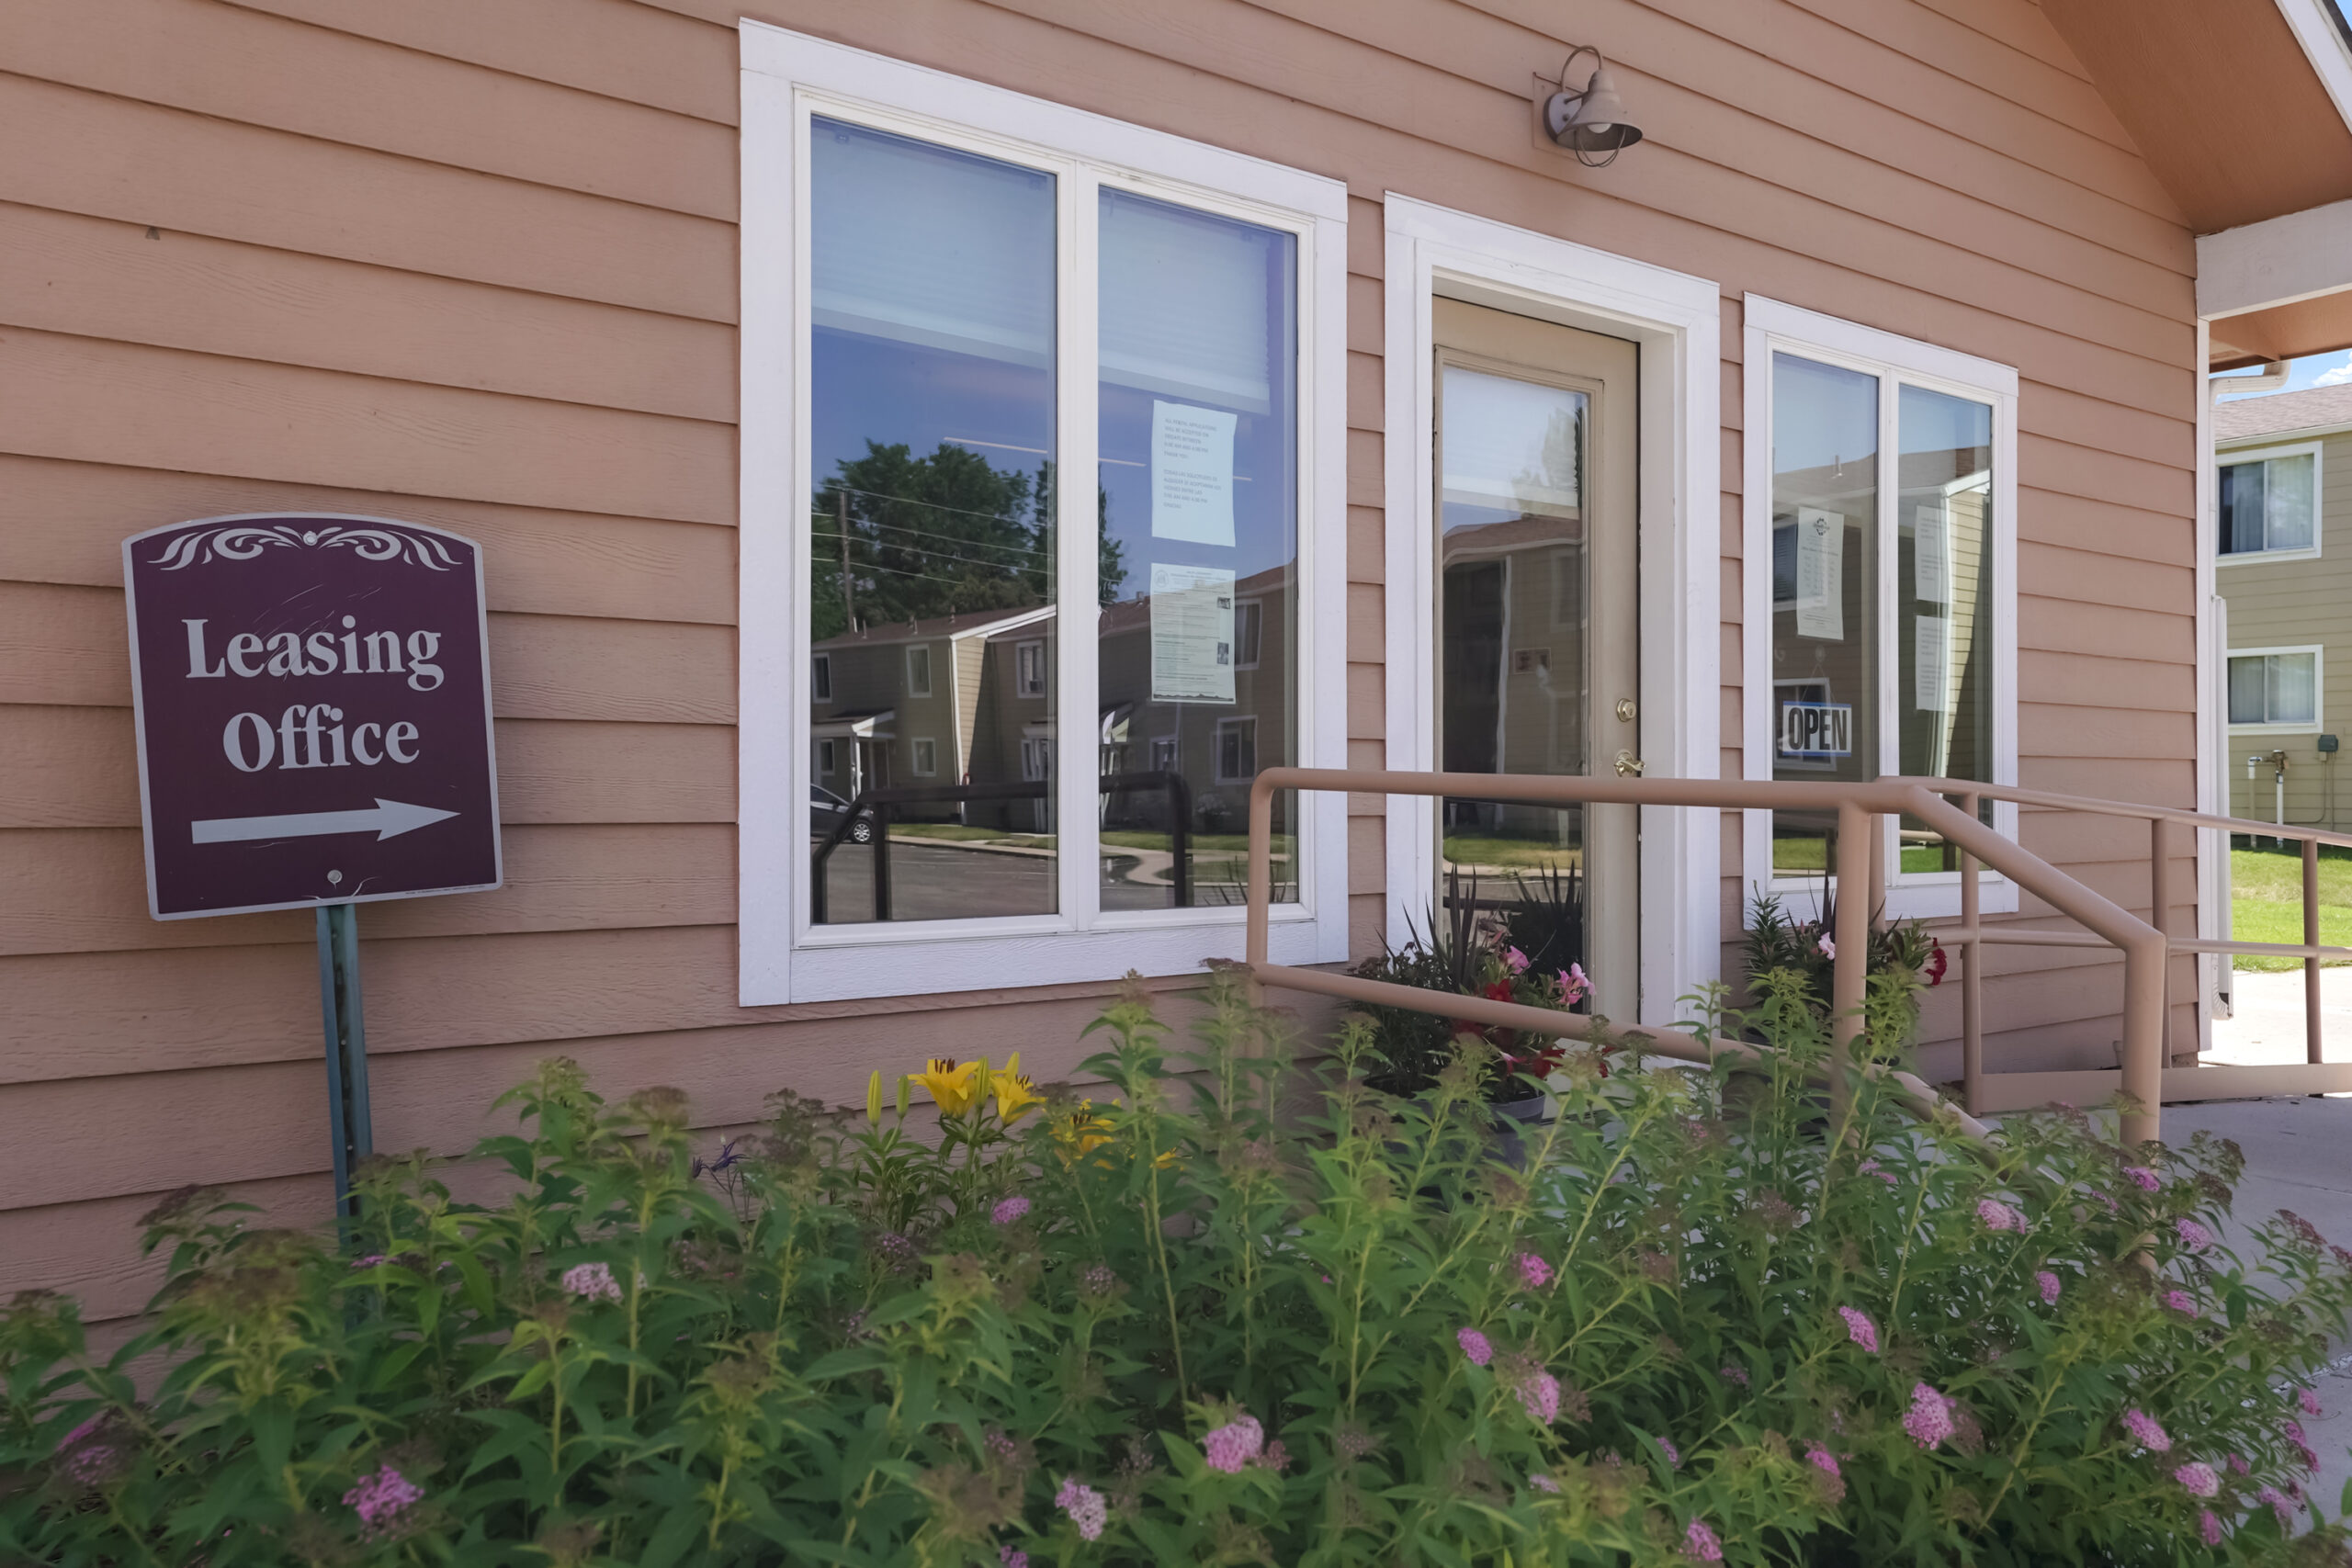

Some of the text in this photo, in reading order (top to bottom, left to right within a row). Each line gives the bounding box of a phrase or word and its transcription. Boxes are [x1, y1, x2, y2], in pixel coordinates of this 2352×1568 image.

[181, 615, 445, 692] Leasing
[222, 704, 420, 773] Office
[1788, 706, 1848, 751] OPEN
